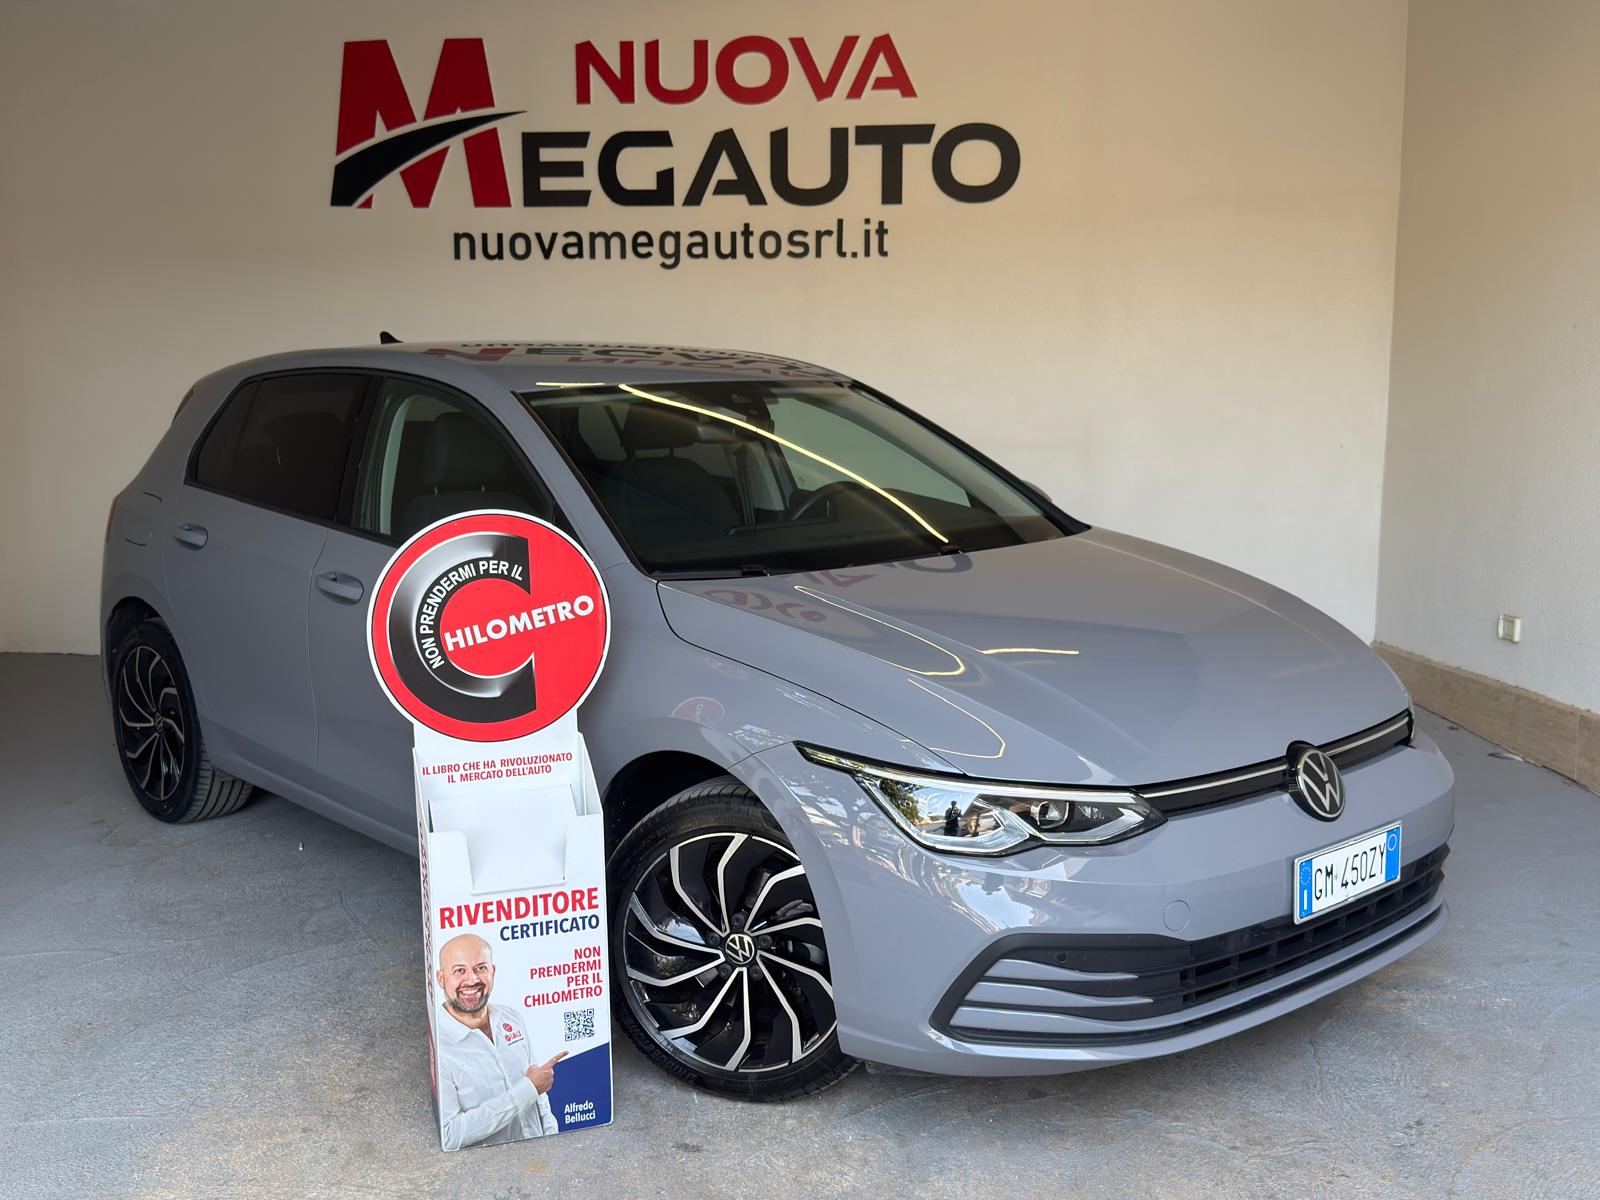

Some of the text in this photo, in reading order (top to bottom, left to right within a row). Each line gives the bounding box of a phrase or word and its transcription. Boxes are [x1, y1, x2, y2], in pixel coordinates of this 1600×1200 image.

[575, 33, 918, 105] NUOVA
[453, 218, 889, 270] nuovamegautosrl.it
[420, 560, 523, 669] NON PRENDERMI PER IL
[422, 752, 573, 776] IL LIBRO CHE HA RIVOLUZIONATO
[447, 765, 552, 783] IL MERCATO DELL'AUTO
[1314, 863, 1334, 901] GM
[1341, 842, 1386, 890] 450ZY
[439, 887, 599, 929] RIVENDITORE
[499, 914, 600, 942] CERTIFICATO
[574, 945, 601, 960] NON
[530, 959, 602, 980] PRENDERMI
[567, 972, 603, 988] PER IL
[524, 985, 603, 1008] CHILOMETRO
[564, 1100, 594, 1114] Alfredo
[565, 1109, 596, 1124] Bellucci
